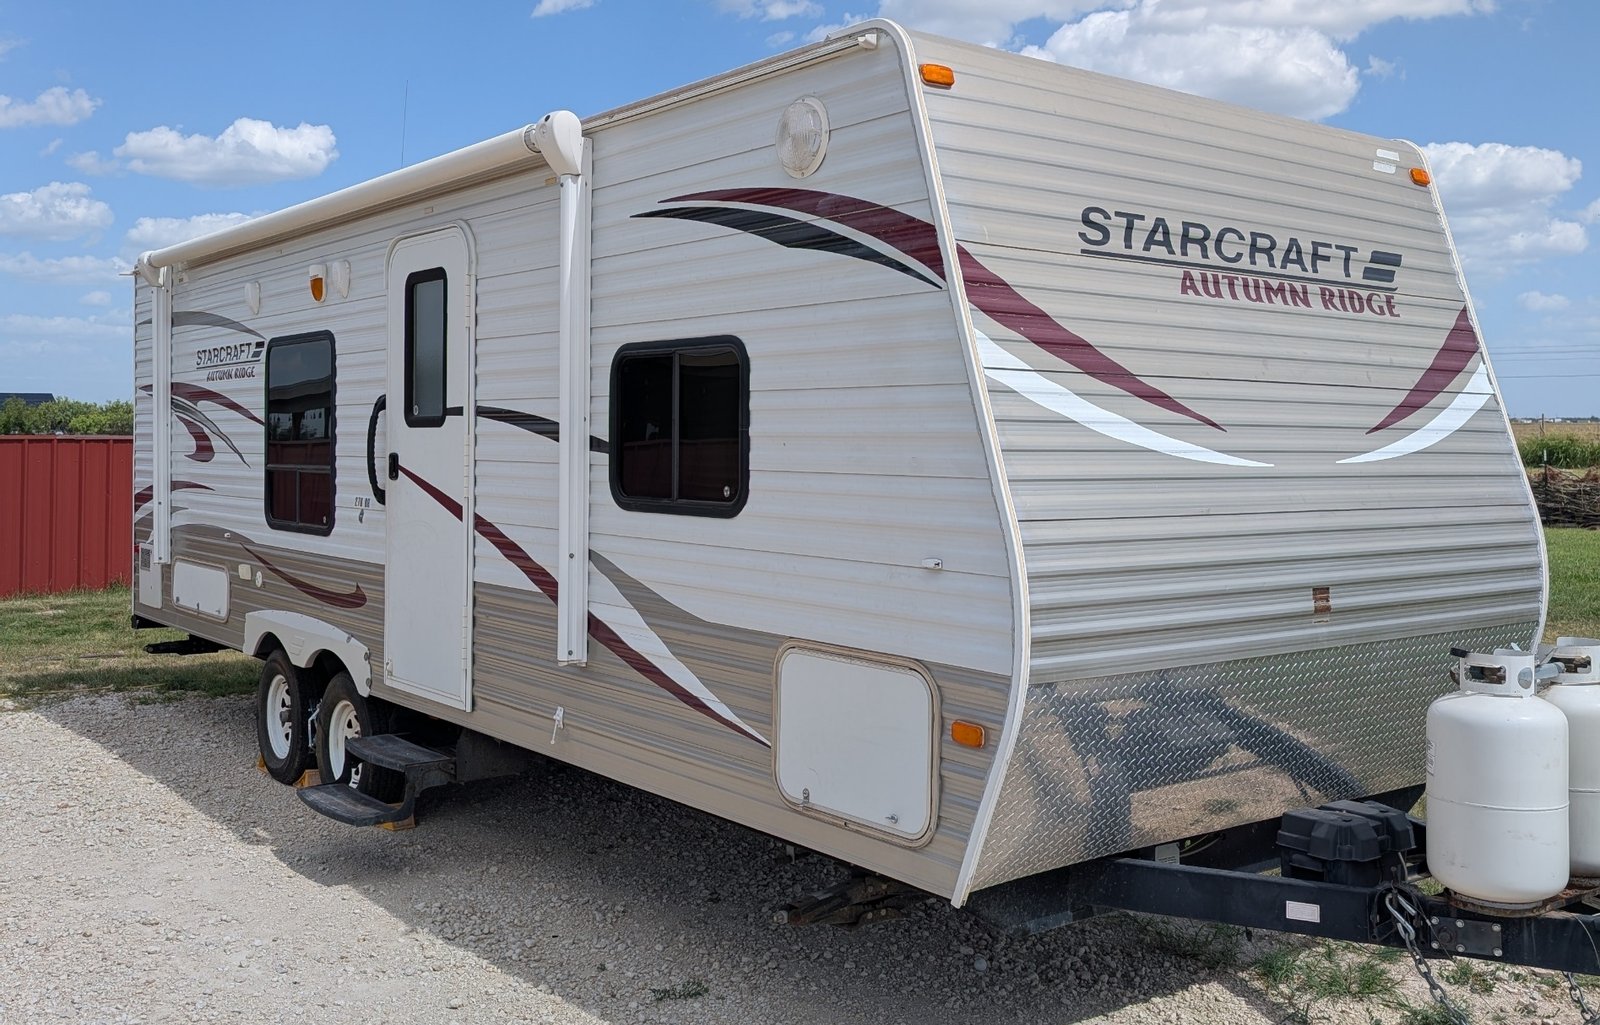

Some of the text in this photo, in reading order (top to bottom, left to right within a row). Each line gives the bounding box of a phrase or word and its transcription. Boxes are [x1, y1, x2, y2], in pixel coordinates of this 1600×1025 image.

[1078, 206, 1358, 279] STARCRAFT
[1181, 270, 1401, 318] AUTUMN RIDGE
[196, 342, 252, 366] STARCRAFT
[206, 366, 256, 382] AUTUMN RIDGE
